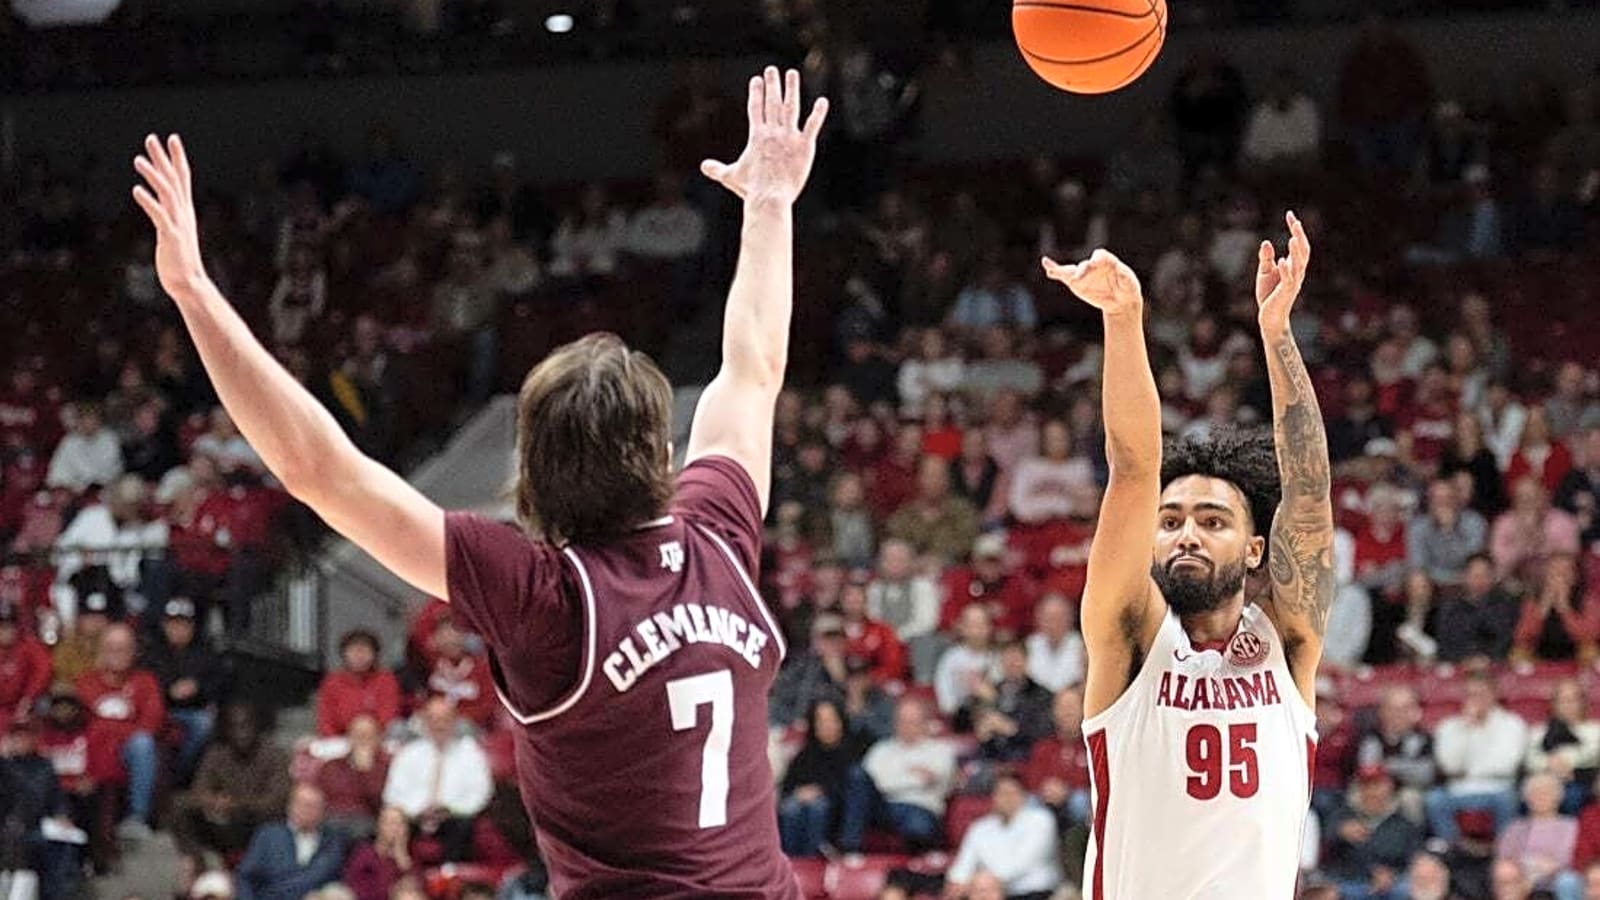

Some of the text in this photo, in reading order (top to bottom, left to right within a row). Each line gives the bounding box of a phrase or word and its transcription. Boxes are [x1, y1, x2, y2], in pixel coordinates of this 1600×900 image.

[1232, 633, 1260, 659] SEC
[1157, 670, 1281, 711] ALABAMA
[666, 669, 734, 828] 7
[1185, 723, 1259, 800] 95
